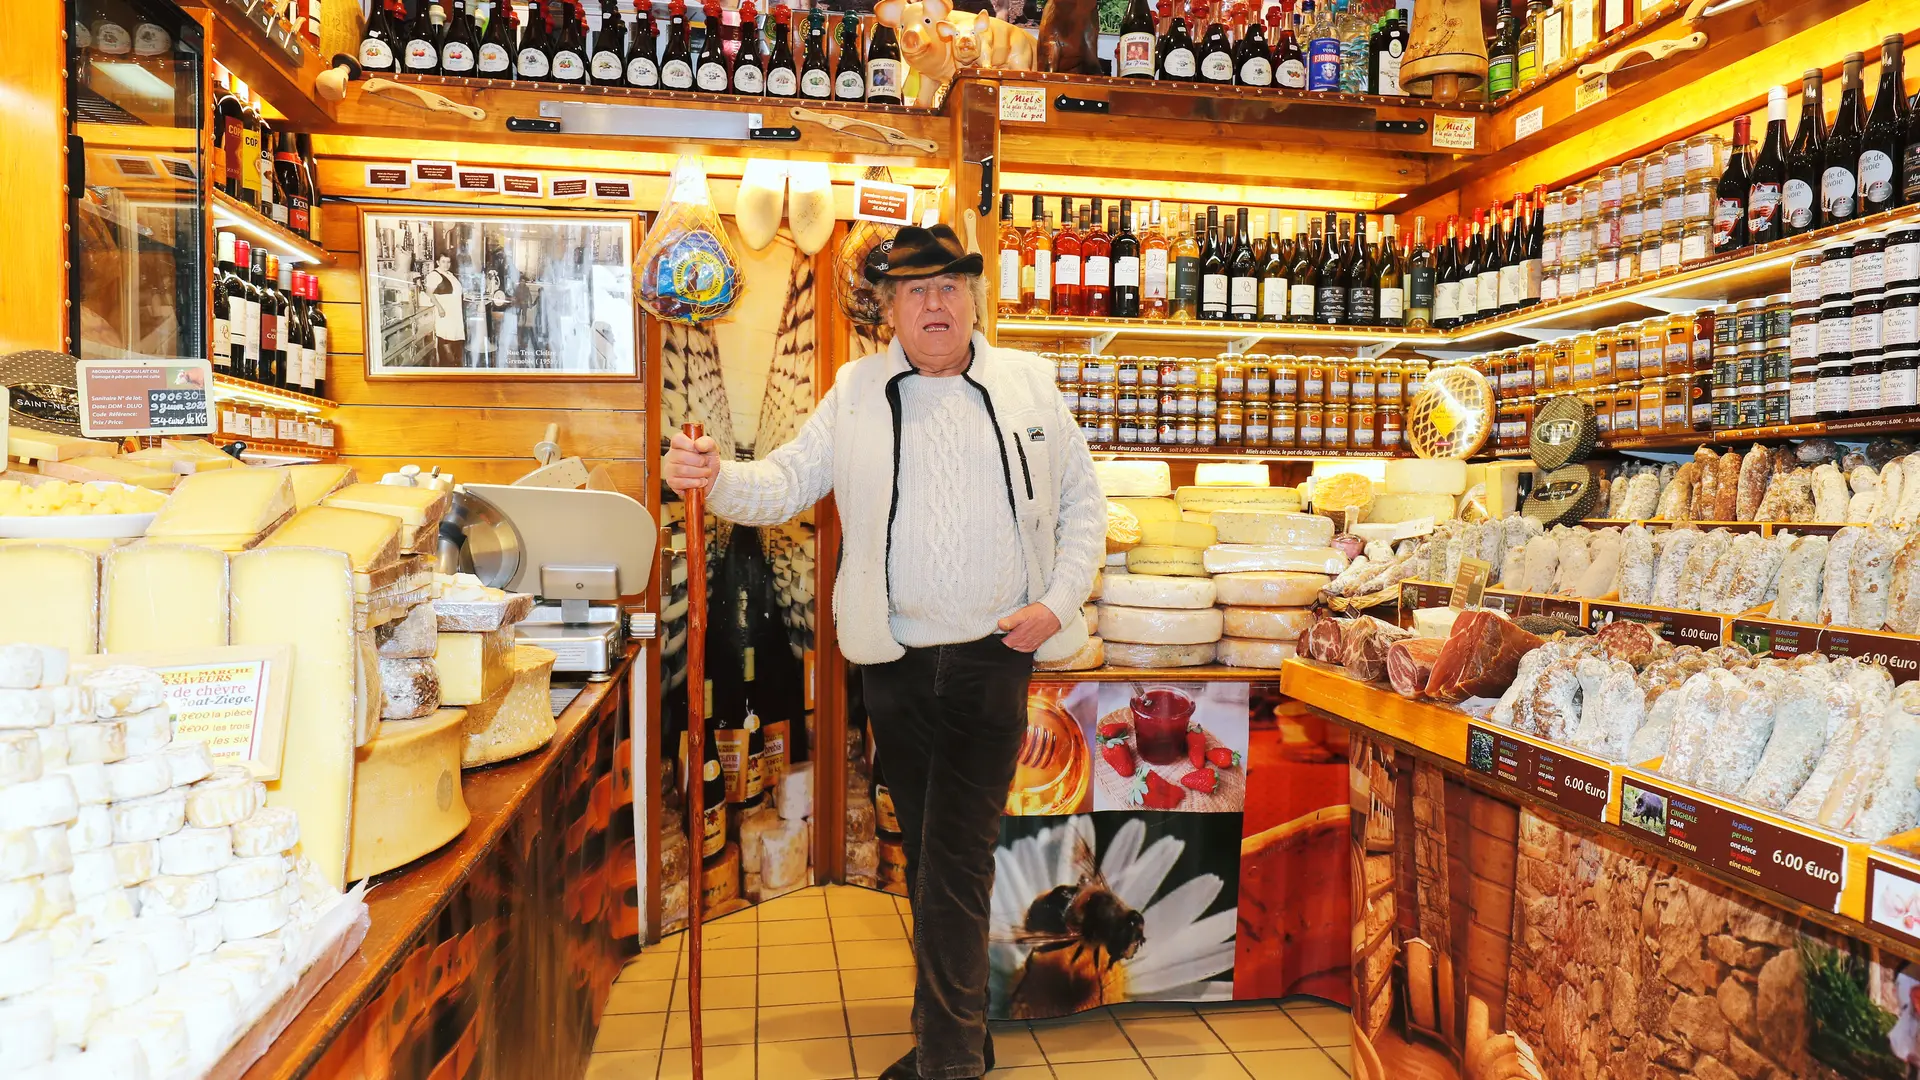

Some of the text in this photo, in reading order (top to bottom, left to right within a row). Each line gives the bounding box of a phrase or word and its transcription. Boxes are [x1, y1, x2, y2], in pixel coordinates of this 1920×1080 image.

[1010, 94, 1034, 104] Miel
[228, 125, 242, 137] COP
[1444, 123, 1463, 131] Miel
[245, 136, 258, 147] COP
[1873, 153, 1884, 162] de
[1837, 170, 1847, 178] de
[17, 398, 79, 412] SAINT-NECT
[185, 400, 207, 411] 2020
[1680, 628, 1719, 642] 6.00 €uro
[1774, 636, 1799, 644] BEAUFORT
[1774, 644, 1799, 652] BEAUFORT
[1862, 652, 1918, 670] 6.00 €uro
[174, 674, 232, 686] SAVEURS
[173, 686, 191, 698] de
[196, 684, 246, 697] chèvre
[212, 711, 221, 719] la
[224, 709, 253, 720] pièce
[212, 724, 226, 732] les
[230, 722, 250, 731] trois
[213, 736, 249, 745] les six
[1564, 775, 1584, 792] 6.00
[1584, 782, 1606, 800] €uro
[1671, 800, 1696, 813] SANGLIER
[1670, 808, 1698, 824] CINGHIALE
[1670, 818, 1684, 830] BOAR
[1738, 822, 1754, 833] pièce
[1731, 832, 1754, 843] per uno
[1730, 842, 1757, 856] one piece
[1728, 860, 1761, 877] eine münze
[1772, 850, 1840, 884] 6.00 €uro
